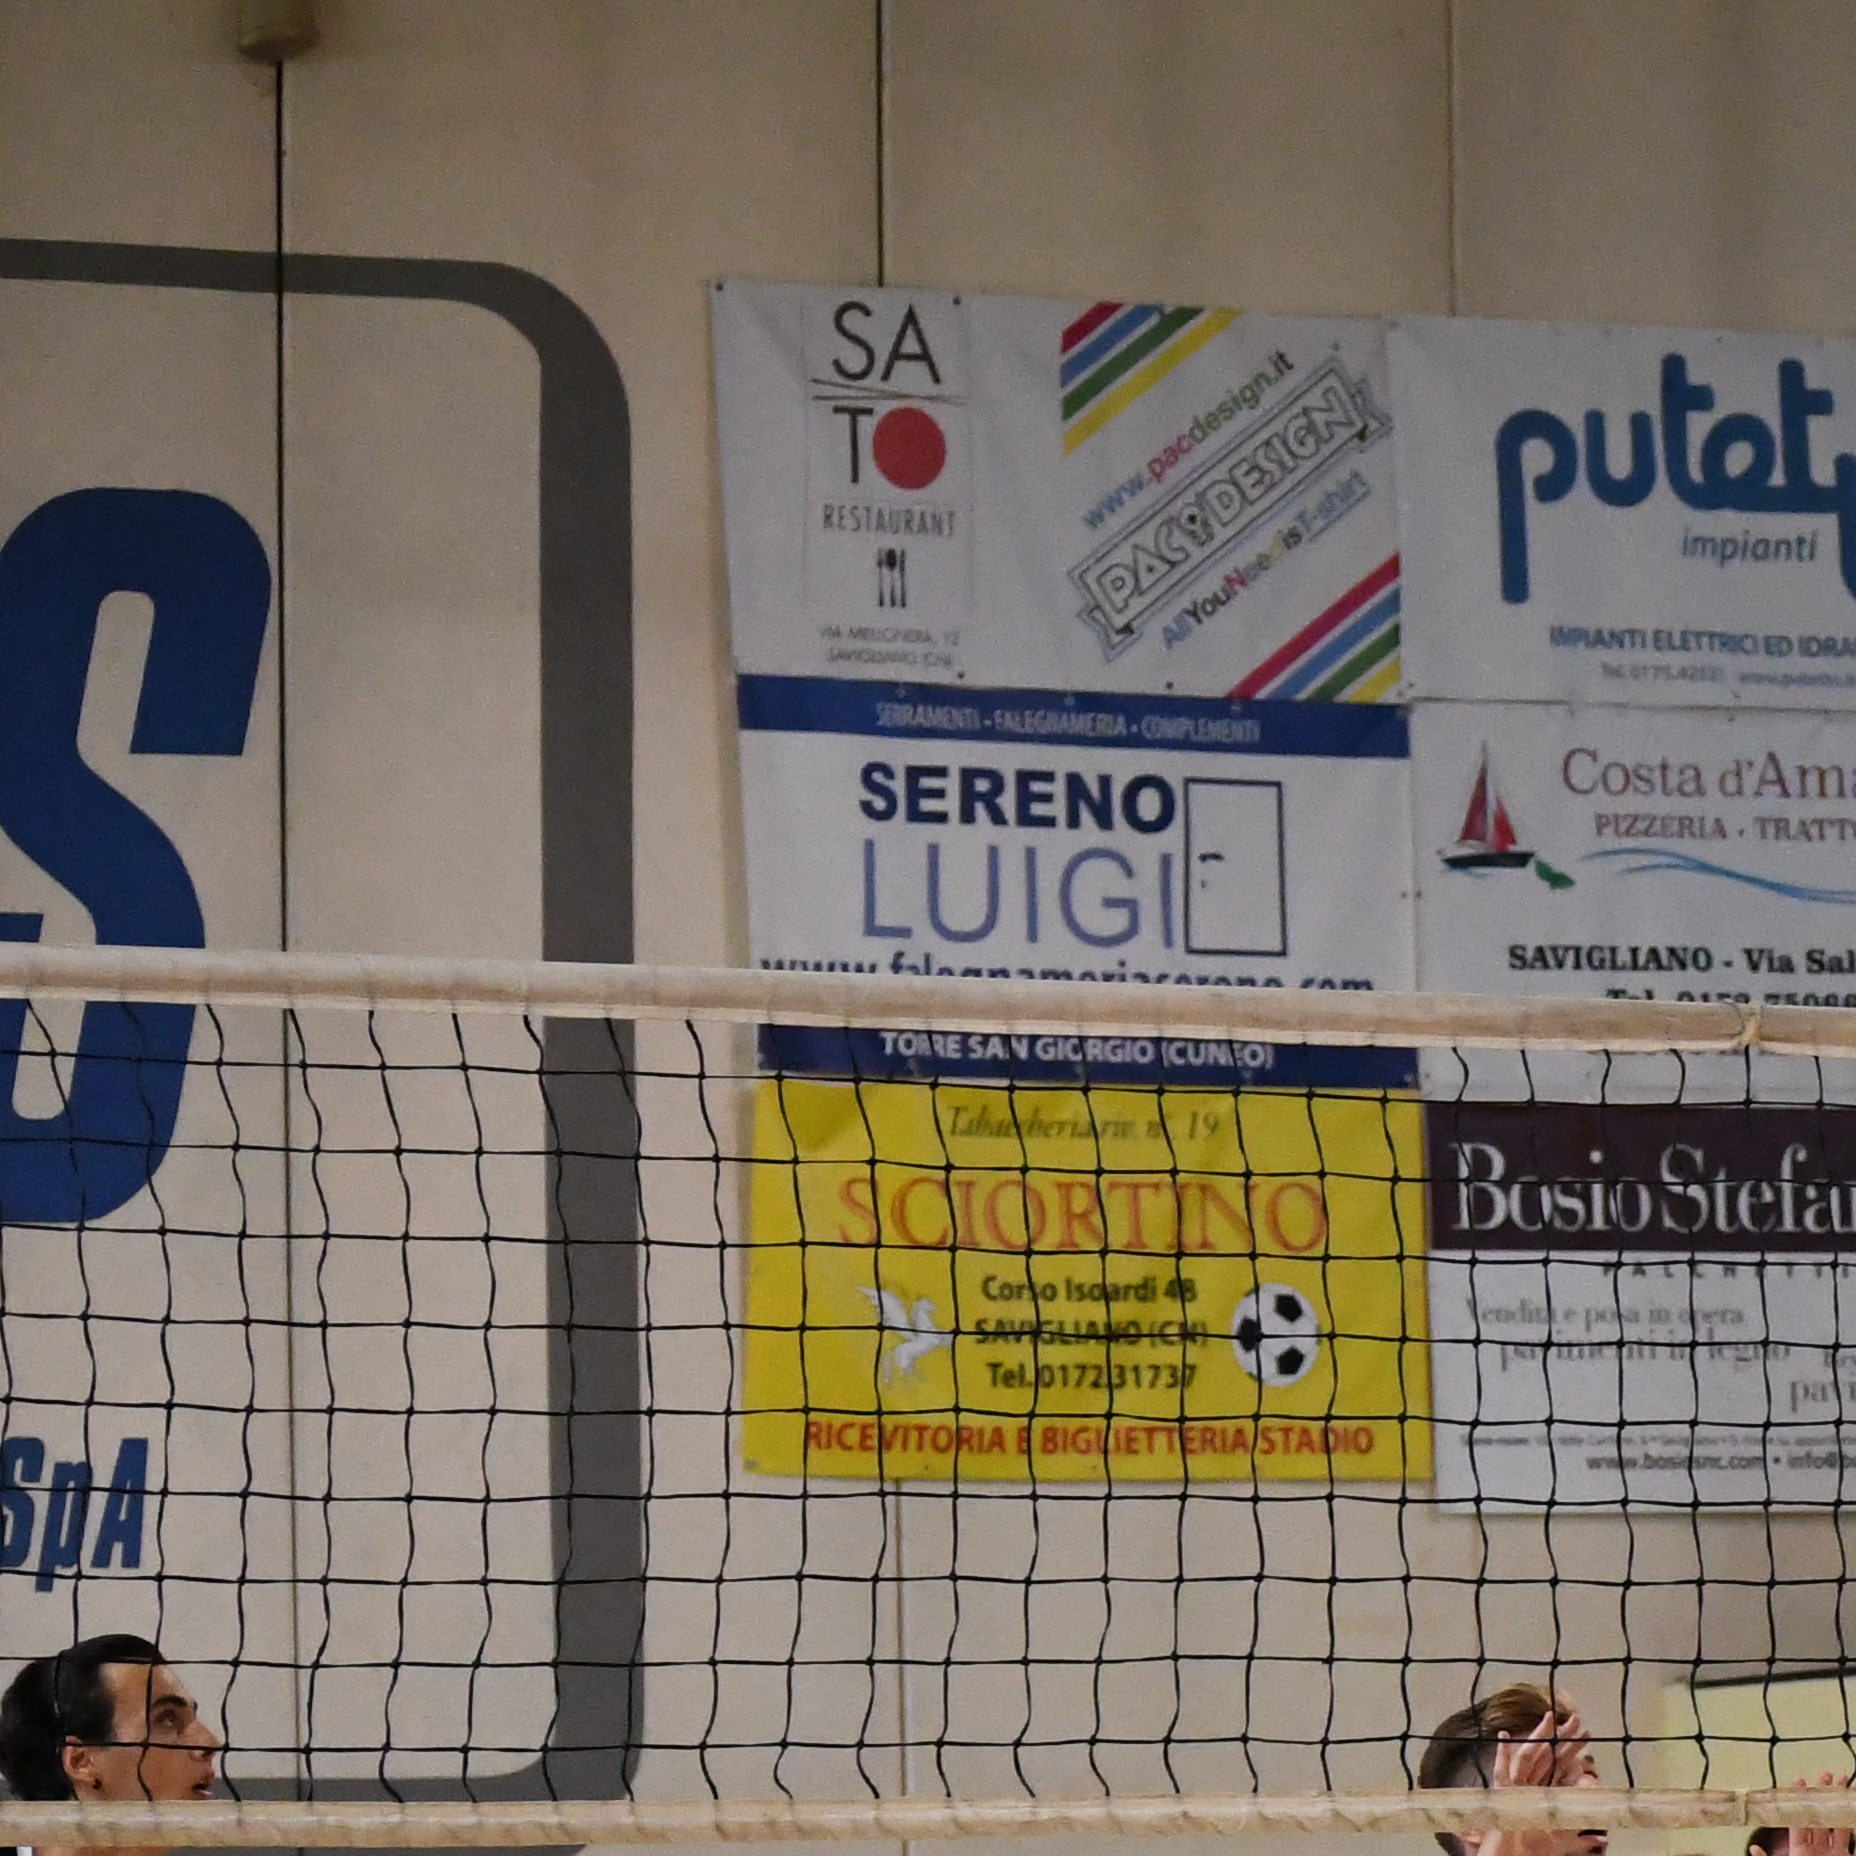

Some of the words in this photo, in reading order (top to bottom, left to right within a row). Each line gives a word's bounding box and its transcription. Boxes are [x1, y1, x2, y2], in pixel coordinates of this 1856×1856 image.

[822, 503, 957, 538] RESTAURANT
[1681, 528, 1819, 569] impianti
[1763, 634, 1795, 657] ED
[993, 710, 1127, 737] FALEGNAMERIA
[1561, 746, 1703, 799] Costa
[857, 761, 1177, 835] SERENO
[1593, 811, 1728, 841] PIZZERIA
[861, 837, 1177, 950] LUIGI
[1508, 943, 1713, 973] SAVIGLIANO
[1743, 947, 1796, 975] Via
[880, 1031, 961, 1059] TORRE
[968, 1033, 1028, 1061] SAN
[1035, 1036, 1154, 1067] GIORGIO
[1449, 1142, 1653, 1232] Bosio
[838, 1176, 1327, 1253] SCIORTINO
[981, 1275, 1058, 1302] Corso
[805, 1420, 1001, 1454] RICEVITORIA
[1016, 1425, 1031, 1453] E
[1040, 1425, 1250, 1456] BIGLIETTERIA
[1259, 1430, 1375, 1455] STADIO
